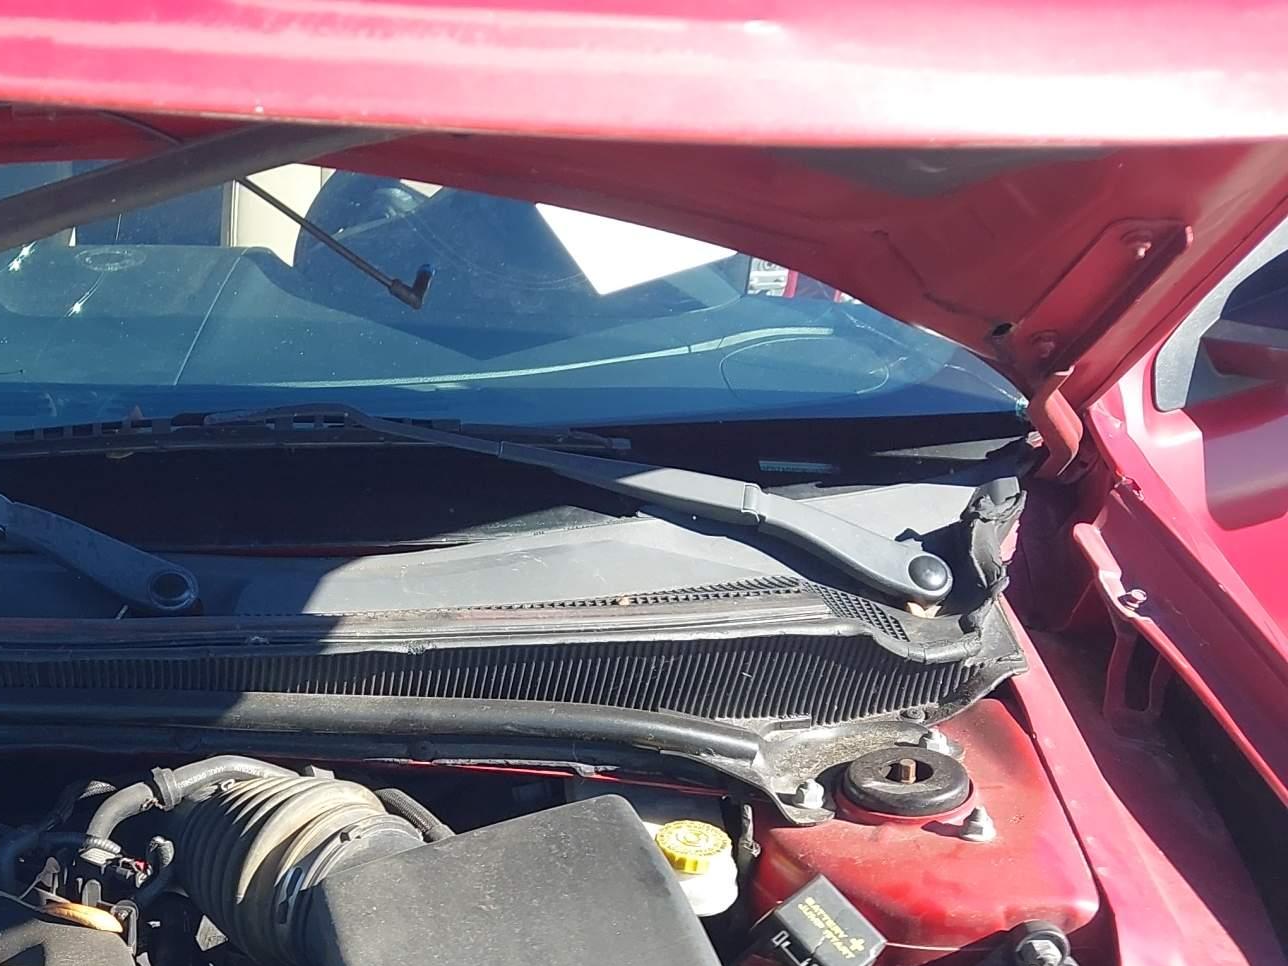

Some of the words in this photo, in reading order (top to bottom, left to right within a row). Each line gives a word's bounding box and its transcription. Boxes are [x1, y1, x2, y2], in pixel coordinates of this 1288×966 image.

[797, 903, 825, 929] JUMP
[823, 929, 856, 959] START
[804, 896, 848, 938] BATTERY
